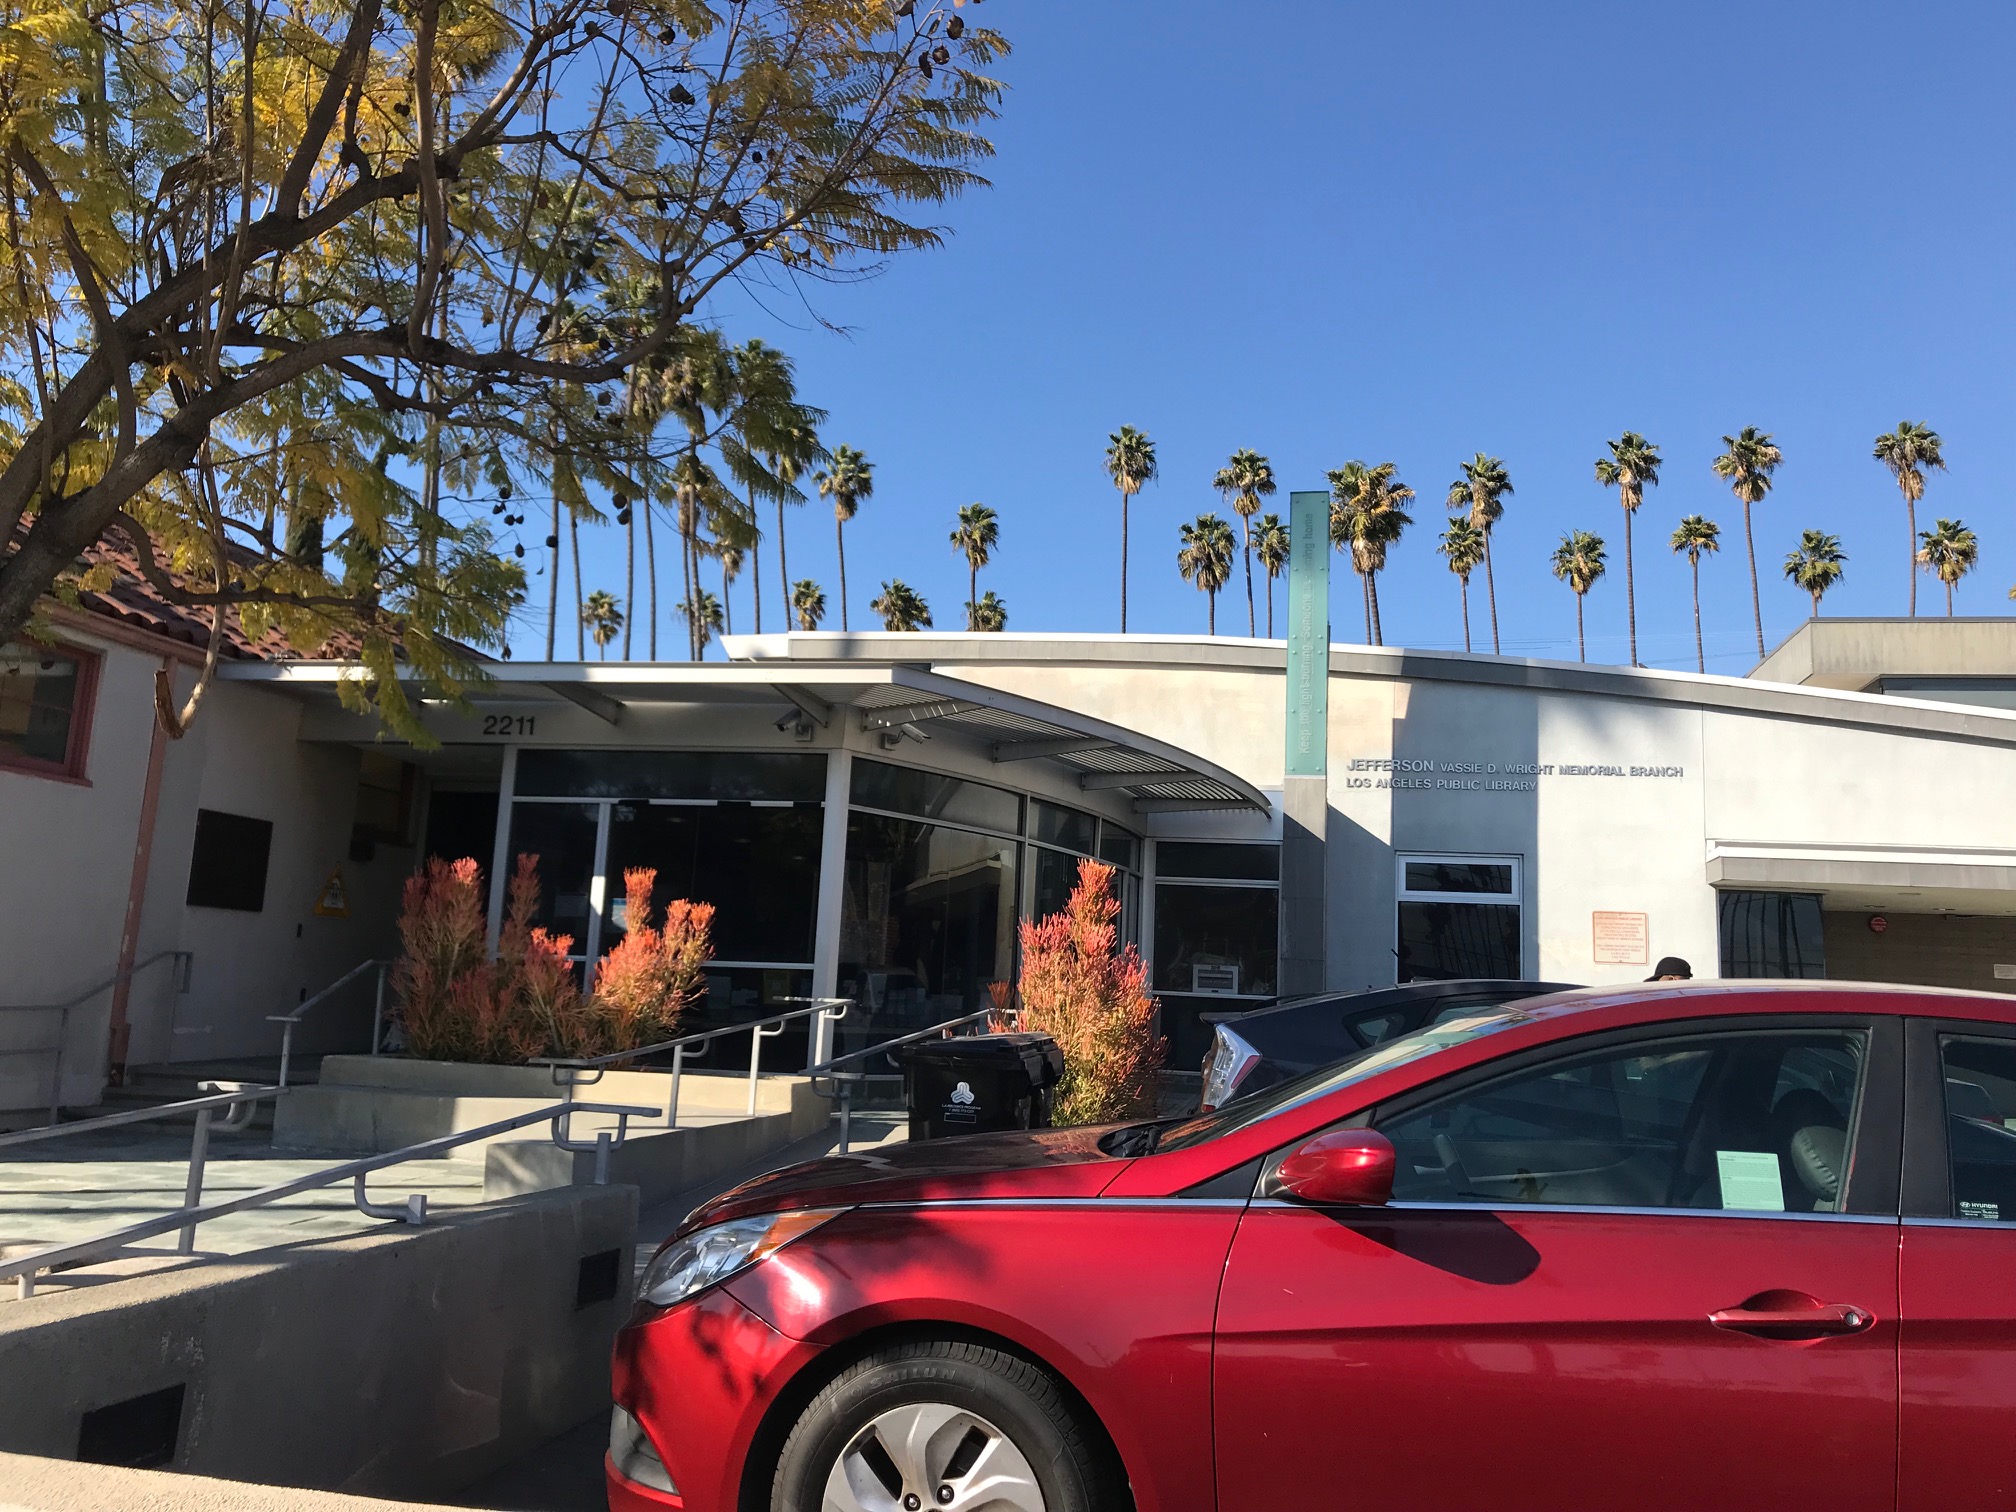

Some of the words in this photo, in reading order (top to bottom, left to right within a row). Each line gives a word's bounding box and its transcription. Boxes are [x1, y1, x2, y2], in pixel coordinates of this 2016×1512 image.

[1302, 514, 1314, 539] home
[483, 715, 535, 735] 2211
[1298, 729, 1312, 754] Keep
[1347, 759, 1434, 772] JEFFERSON
[1440, 763, 1482, 773] VASSIE
[1487, 763, 1500, 774] D.
[1504, 764, 1554, 775] WRIGHT
[1559, 765, 1626, 776] MEMORIAL
[1629, 766, 1683, 777] BRANCH
[1346, 778, 1372, 788] LOS
[1375, 778, 1432, 789] ANGELES
[1436, 779, 1480, 790] PUBLIC
[1485, 780, 1537, 791] LIBRARY
[870, 1367, 956, 1389] SAILUN
